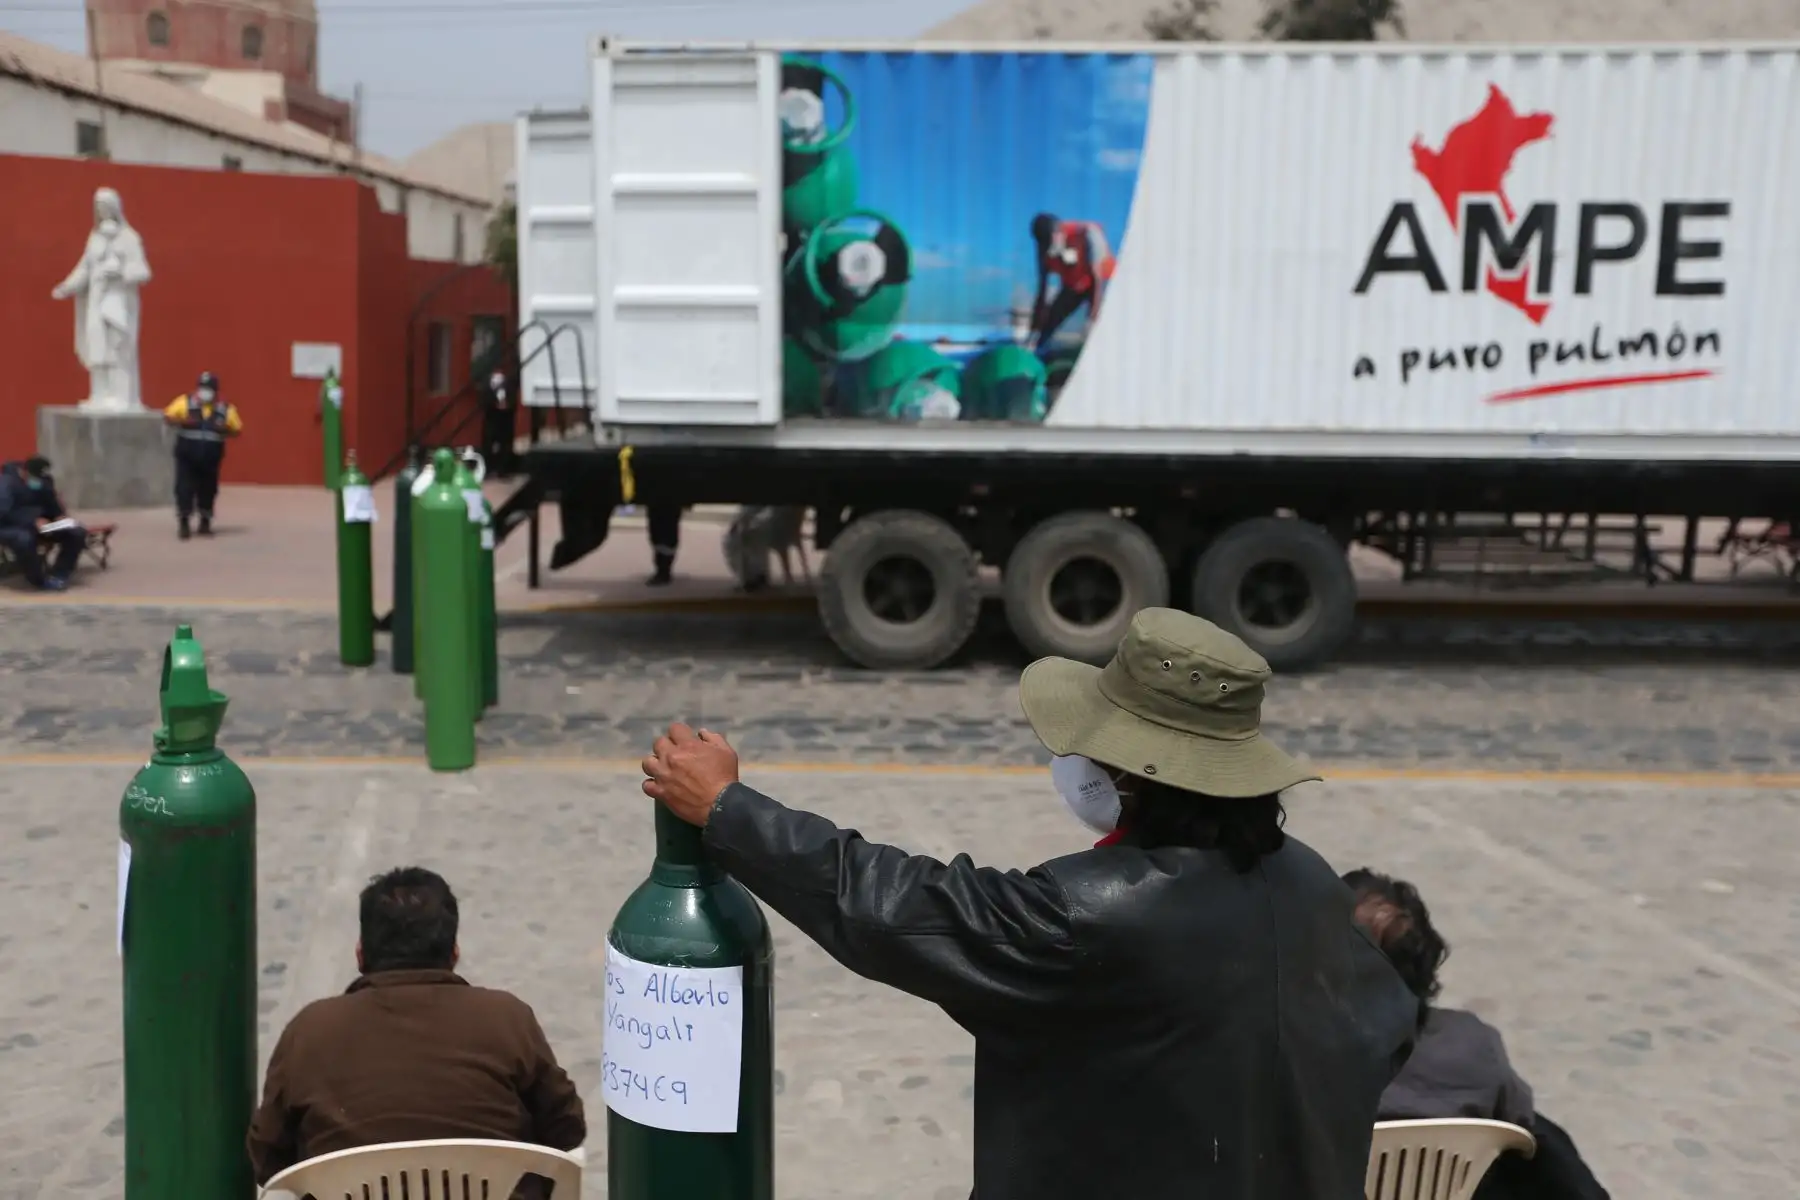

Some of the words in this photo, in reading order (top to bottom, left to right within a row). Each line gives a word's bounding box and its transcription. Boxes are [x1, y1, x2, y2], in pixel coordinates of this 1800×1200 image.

[1352, 200, 1731, 296] AMPE
[1353, 355, 1375, 381] a
[1401, 340, 1503, 384] puro
[606, 970, 625, 995] os
[643, 972, 730, 1007] Alberto
[608, 998, 693, 1050] Yangali
